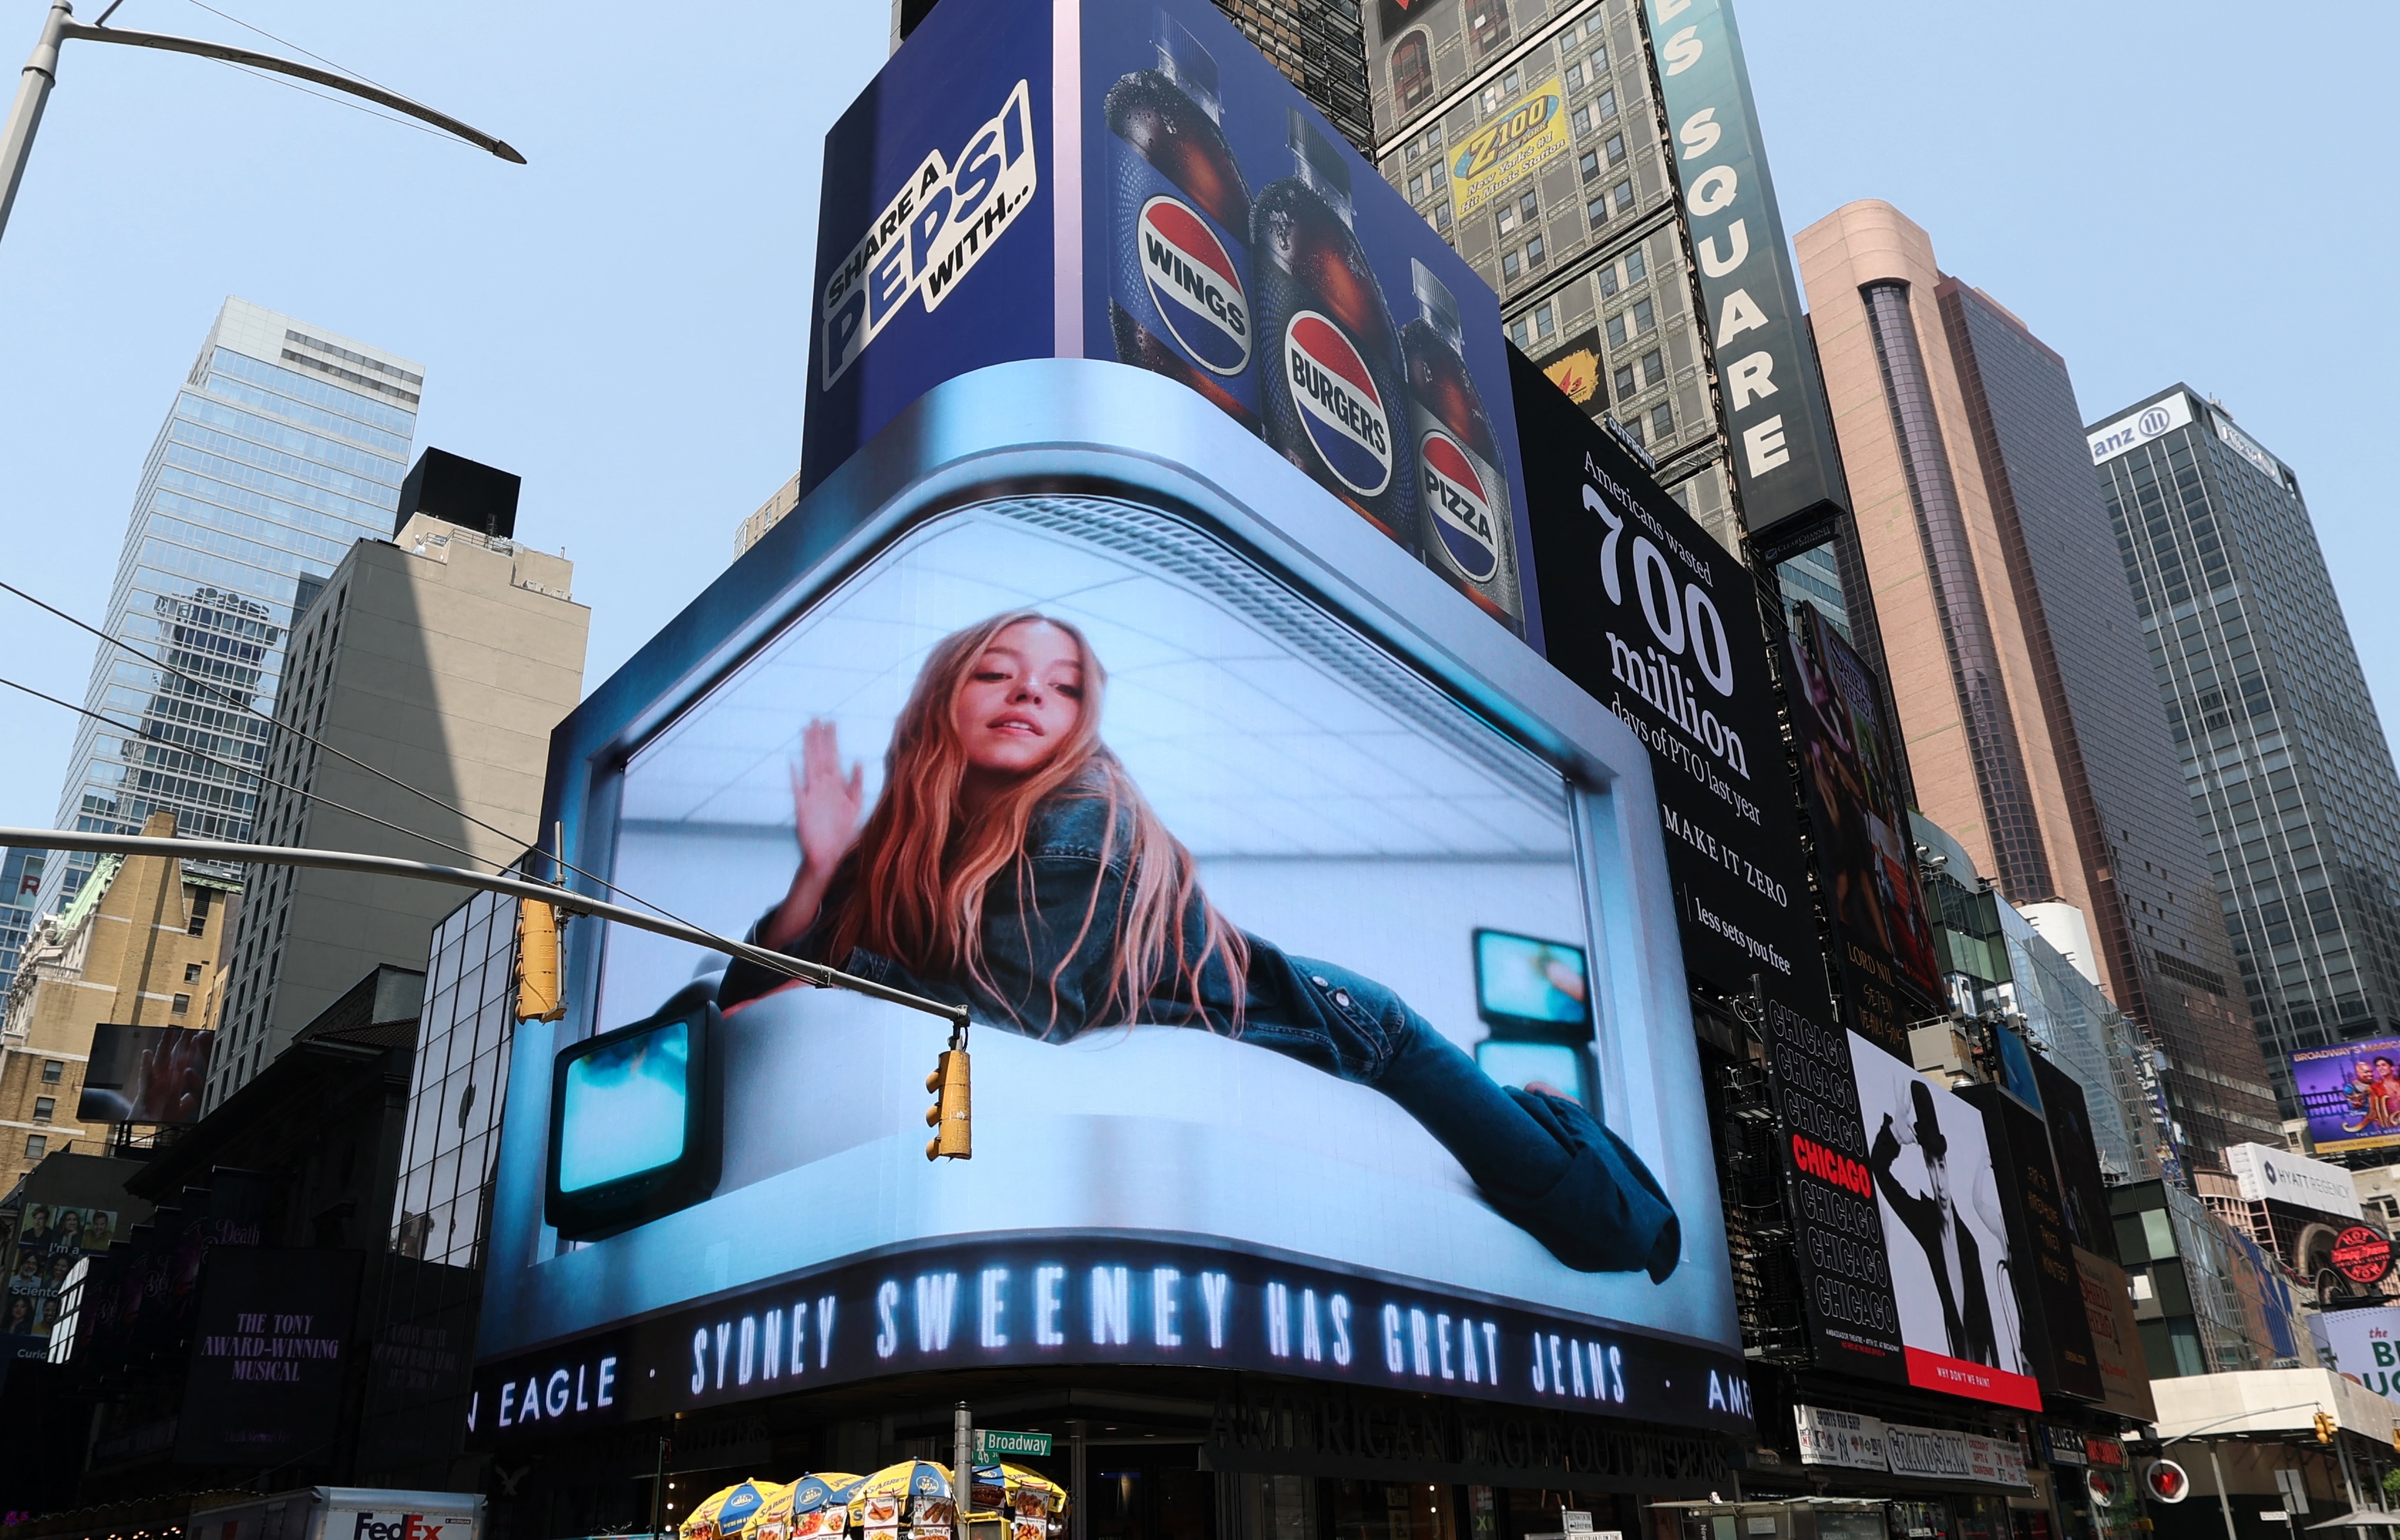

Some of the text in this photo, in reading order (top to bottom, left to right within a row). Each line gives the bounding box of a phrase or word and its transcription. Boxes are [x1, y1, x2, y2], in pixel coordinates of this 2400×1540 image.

[1467, 95, 1549, 180] Z100
[1467, 131, 1553, 197] New York's #1
[1499, 120, 1549, 159] NEW YORK
[1460, 139, 1566, 214] Hit Music Station
[827, 91, 1025, 381] PEPSI
[829, 162, 940, 308] SHARE A
[928, 184, 1029, 299] WITH...
[1145, 231, 1245, 337] WINGS
[1679, 107, 1791, 479] SQUARE
[1290, 347, 1387, 456] BURGERS
[1424, 462, 1494, 546] PIZZA
[1584, 450, 1714, 588] Americans wasted
[1582, 483, 1734, 697] 700
[1829, 637, 1872, 704] SHIELD
[1605, 631, 1751, 781] million
[1839, 674, 1870, 718] HERO
[1870, 708, 1880, 736] 4
[1611, 692, 1761, 827] days of PTO last year
[1662, 803, 1788, 908] MAKE IT ZERO
[1695, 897, 1792, 976] less sets you free
[1847, 941, 1876, 975] LORD
[1876, 960, 1895, 988] NIL
[1768, 999, 1850, 1073] CHICAGO
[2293, 1046, 2362, 1062] BROADWAY'S
[1776, 1042, 1857, 1115] CHICAGO
[1783, 1088, 1865, 1158] CHICAGO
[1792, 1133, 1872, 1200] CHICAGO
[2277, 1168, 2351, 1199] HYATT REGENCY
[216, 1218, 261, 1246] Death
[1800, 1179, 1880, 1245] CHICAGO
[2342, 1230, 2369, 1245] HOT
[49, 1242, 70, 1253] I'm
[1807, 1226, 1887, 1288] CHICAGO
[2350, 1262, 2381, 1278] NOW
[237, 1313, 314, 1334] THE TONY
[691, 1267, 1625, 1404] SYDNEY SWEENEY HAS GREAT JEANS
[1815, 1274, 1895, 1334] CHICAGO
[2369, 1326, 2388, 1339] the
[201, 1336, 339, 1360] AWARD-WINNING
[231, 1360, 300, 1382] MUSICAL
[1937, 1366, 1949, 1378] WHY
[1950, 1370, 1966, 1383] DON'T
[1966, 1374, 1976, 1385] WE
[500, 1356, 617, 1428] EAGLE
[1816, 1410, 1838, 1428] SPORTS
[978, 1452, 990, 1464] 46
[989, 1434, 1047, 1456] Broadway
[1207, 1388, 1730, 1483] AMERICAN EAGLE OUTFITTERS
[2048, 1426, 2070, 1450] BLUE
[759, 1494, 793, 1518] SABRETT
[854, 1509, 863, 1521] S
[866, 1475, 909, 1494] SABRETT
[356, 1512, 444, 1540] FedEx
